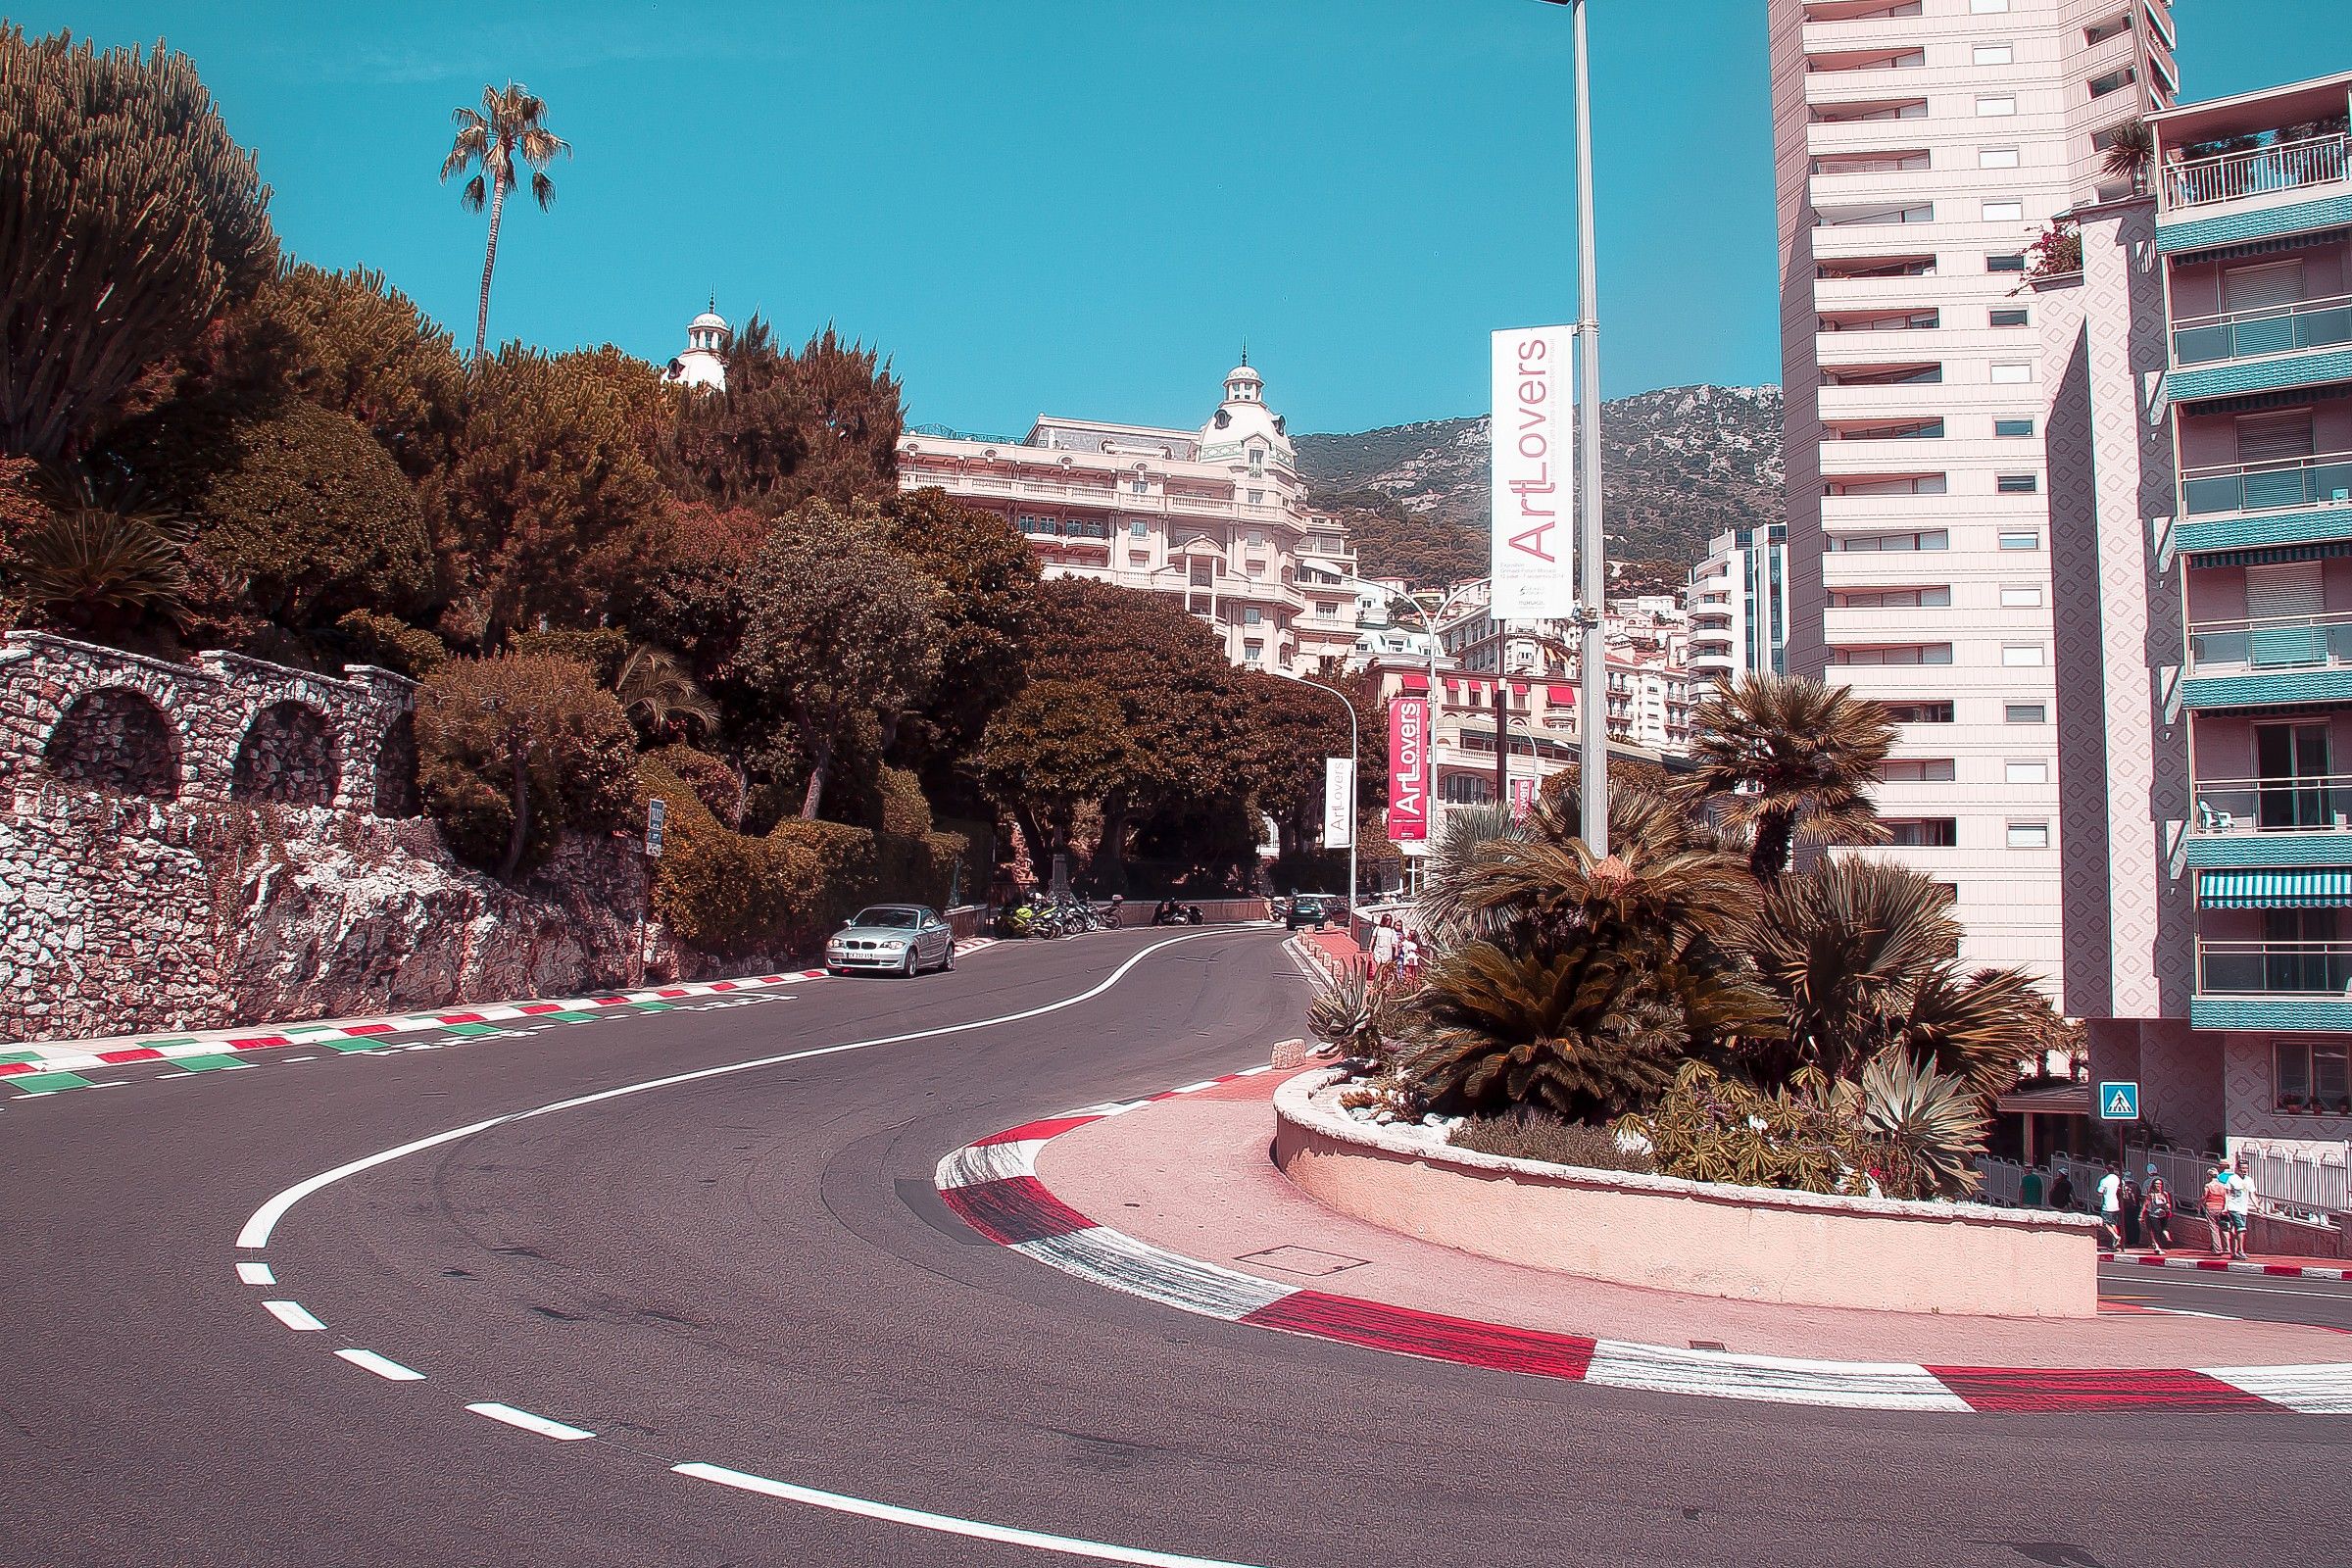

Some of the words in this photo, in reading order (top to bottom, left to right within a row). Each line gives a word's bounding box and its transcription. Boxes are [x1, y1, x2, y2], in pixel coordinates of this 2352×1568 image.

[1508, 339, 1555, 563] ArtLovers
[1330, 762, 1345, 831] ArtLovers
[1395, 703, 1420, 815] ArtLovers
